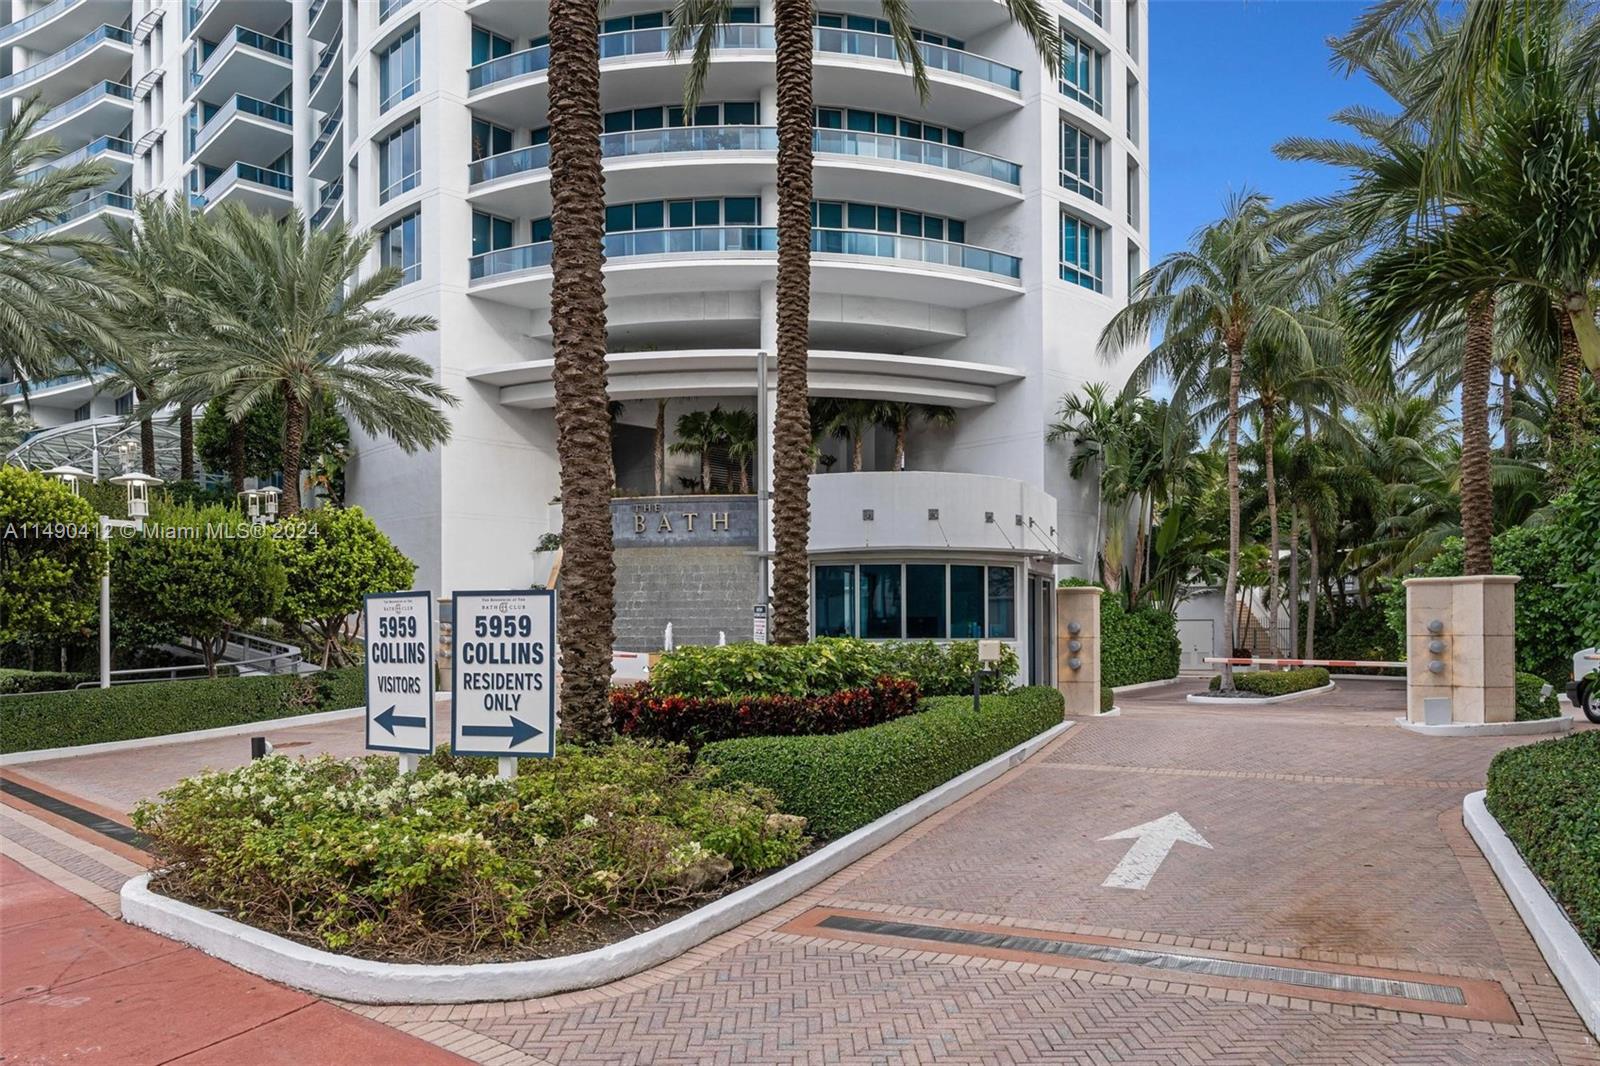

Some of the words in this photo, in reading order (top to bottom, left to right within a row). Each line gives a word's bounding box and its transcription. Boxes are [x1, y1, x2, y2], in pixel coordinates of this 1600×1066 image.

[634, 503, 661, 513] THE
[634, 512, 729, 533] BATH
[379, 616, 417, 638] 5959
[475, 615, 532, 638] 5959
[372, 642, 425, 665] COLLINS
[462, 642, 544, 665] COLLINS
[377, 676, 421, 694] VISITORS
[463, 673, 543, 691] RESIDENTS
[484, 694, 522, 711] ONLY
